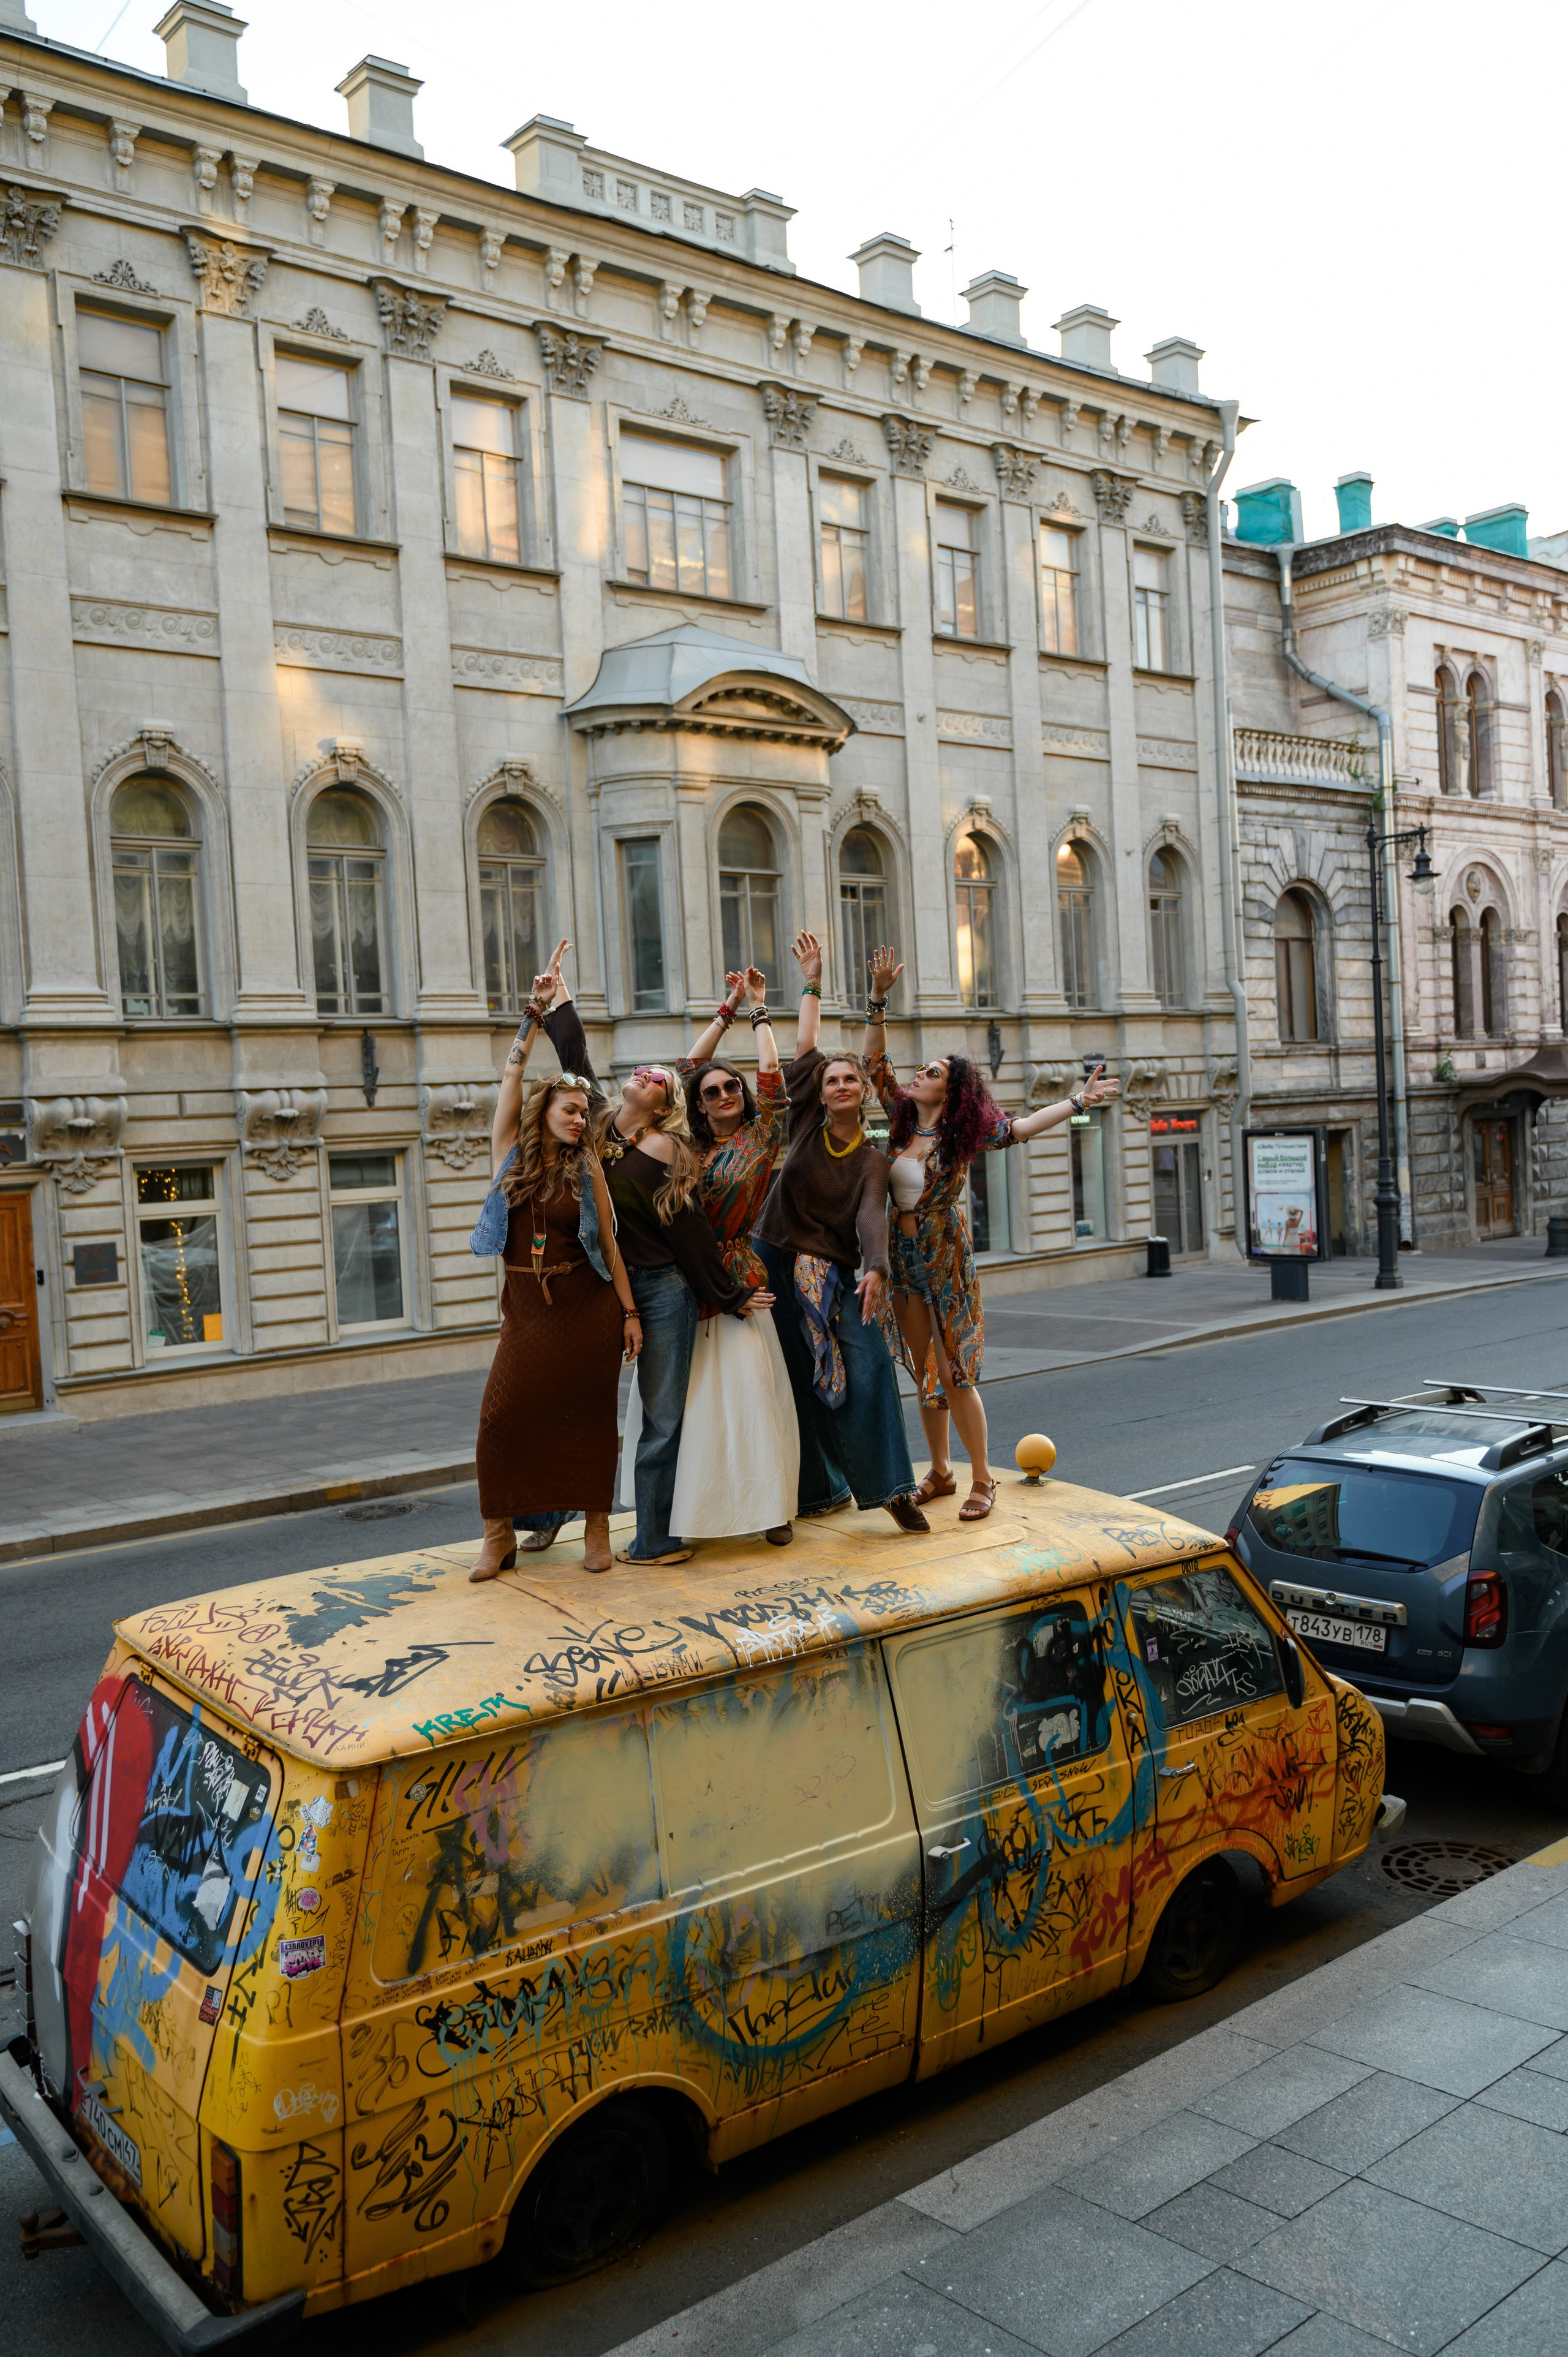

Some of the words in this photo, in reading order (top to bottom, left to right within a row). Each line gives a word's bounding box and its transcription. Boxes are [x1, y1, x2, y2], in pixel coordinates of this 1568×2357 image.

[864, 1129, 891, 1139] ЕРОБЫ
[1272, 1590, 1398, 1623] DUSTER
[1356, 1625, 1381, 1642] 178
[401, 1833, 420, 1844] кстати
[285, 1940, 308, 1951] ХЭЛЛОУ
[309, 1937, 320, 1947] ЁПТ
[435, 1970, 451, 1982] ДВЕРИ
[125, 2140, 136, 2165] 47
